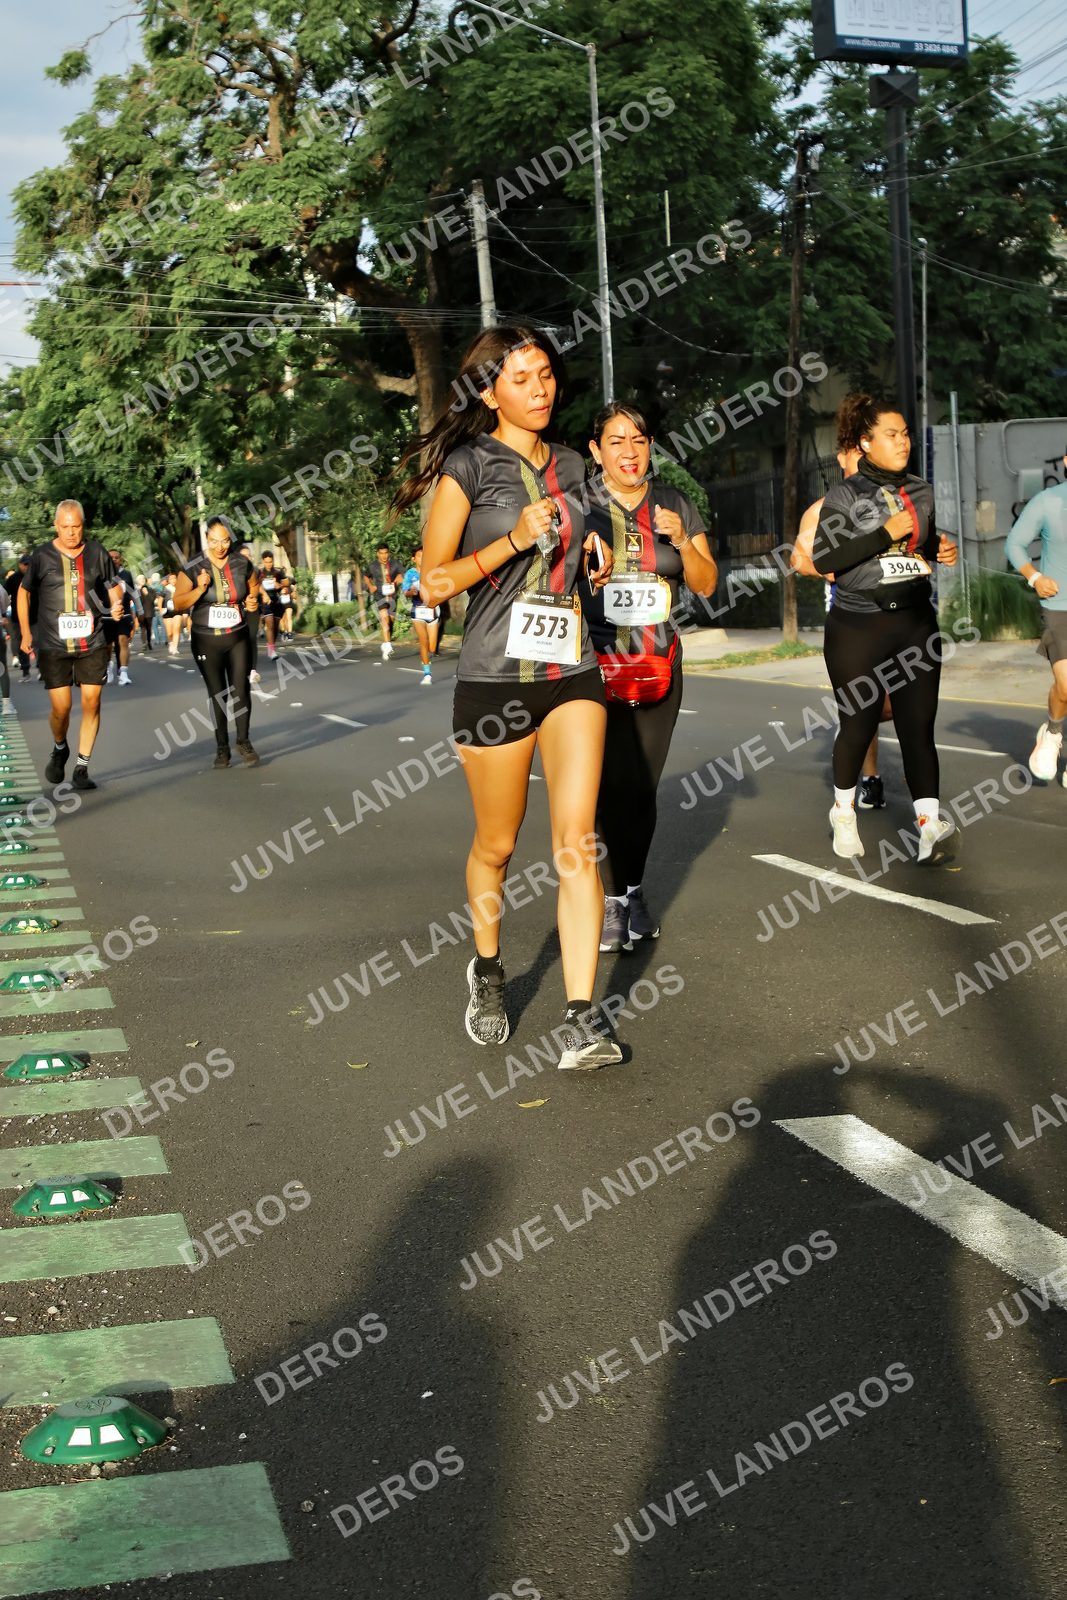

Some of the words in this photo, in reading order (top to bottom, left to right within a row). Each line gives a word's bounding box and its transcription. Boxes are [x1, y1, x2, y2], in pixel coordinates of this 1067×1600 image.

[888, 562, 921, 574] 3944
[613, 589, 657, 607] 2375
[211, 609, 238, 620] 10306
[61, 619, 89, 629] 10307
[521, 612, 569, 639] 7573
